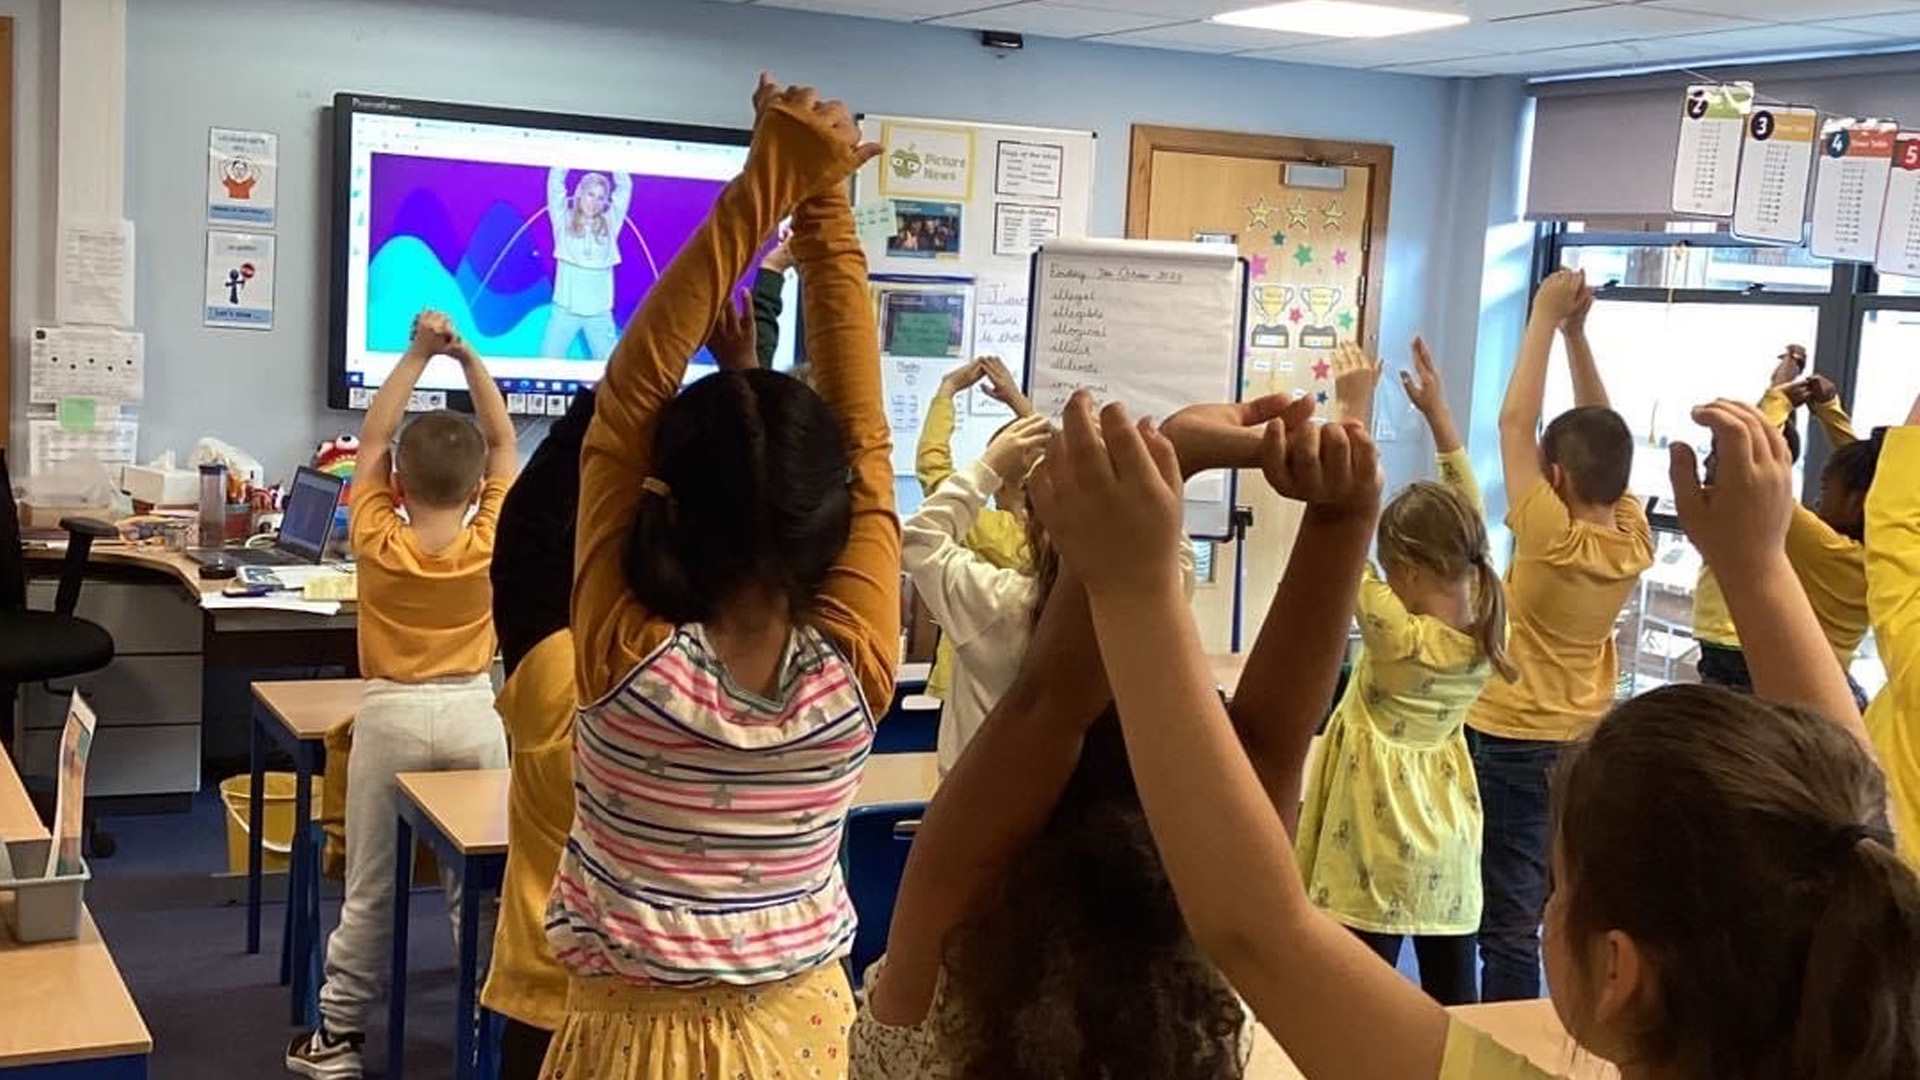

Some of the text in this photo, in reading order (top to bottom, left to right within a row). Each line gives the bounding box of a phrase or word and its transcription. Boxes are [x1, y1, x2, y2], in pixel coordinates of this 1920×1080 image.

[1756, 117, 1768, 136] 3
[1831, 133, 1843, 152] 4
[925, 152, 966, 168] Picture
[1905, 145, 1918, 165] 5
[923, 167, 956, 181] News
